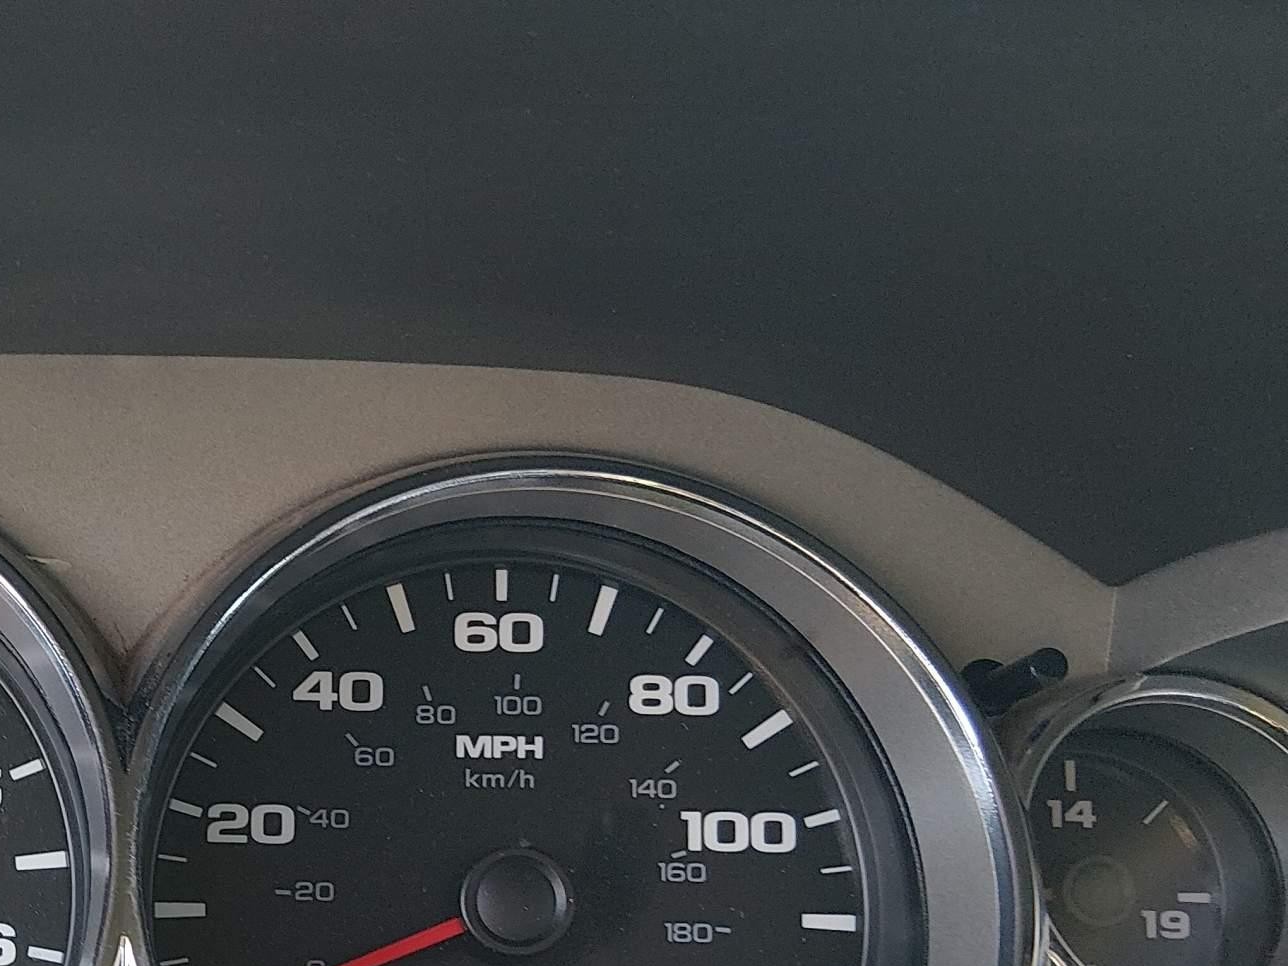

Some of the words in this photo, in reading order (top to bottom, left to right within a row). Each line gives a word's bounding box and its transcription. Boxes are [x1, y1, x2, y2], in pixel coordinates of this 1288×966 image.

[454, 612, 544, 653] 60
[292, 671, 384, 712] 40
[628, 674, 720, 716] 80
[415, 704, 457, 725] 80
[493, 695, 542, 716] 100
[571, 724, 620, 744] 120
[353, 746, 396, 767] 60
[455, 734, 544, 760] MPH
[465, 768, 535, 789] km/h
[628, 778, 677, 799] 140
[206, 803, 296, 845] 20
[308, 809, 350, 829] 40
[1046, 799, 1097, 829] 14
[678, 810, 797, 854] 100
[657, 862, 707, 883] 160
[293, 881, 335, 902] 20
[663, 922, 713, 943] 180
[1140, 910, 1191, 939] 19
